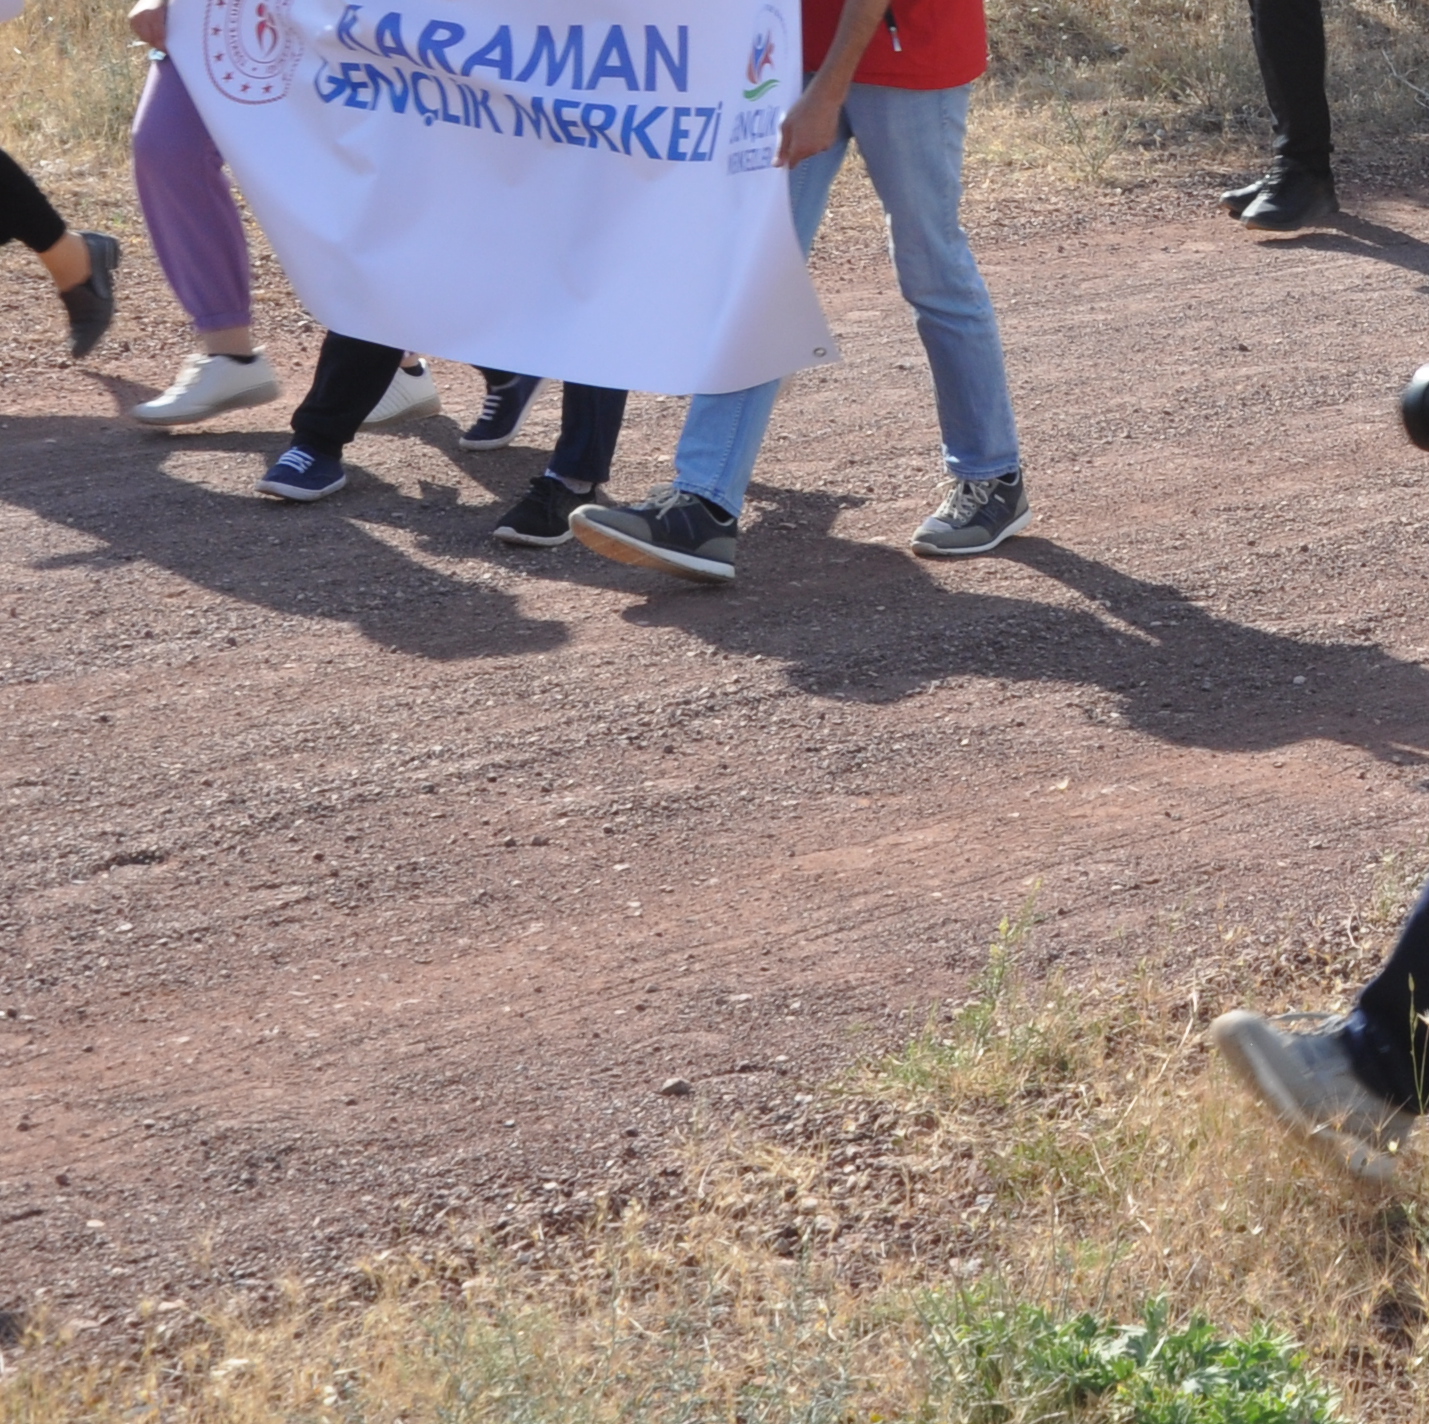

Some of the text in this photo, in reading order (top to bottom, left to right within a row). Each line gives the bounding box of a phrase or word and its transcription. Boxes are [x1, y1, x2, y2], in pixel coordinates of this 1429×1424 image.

[337, 4, 688, 92] KARAMAN
[314, 56, 503, 135] GENÇLİK
[504, 101, 723, 161] MERKEZİ
